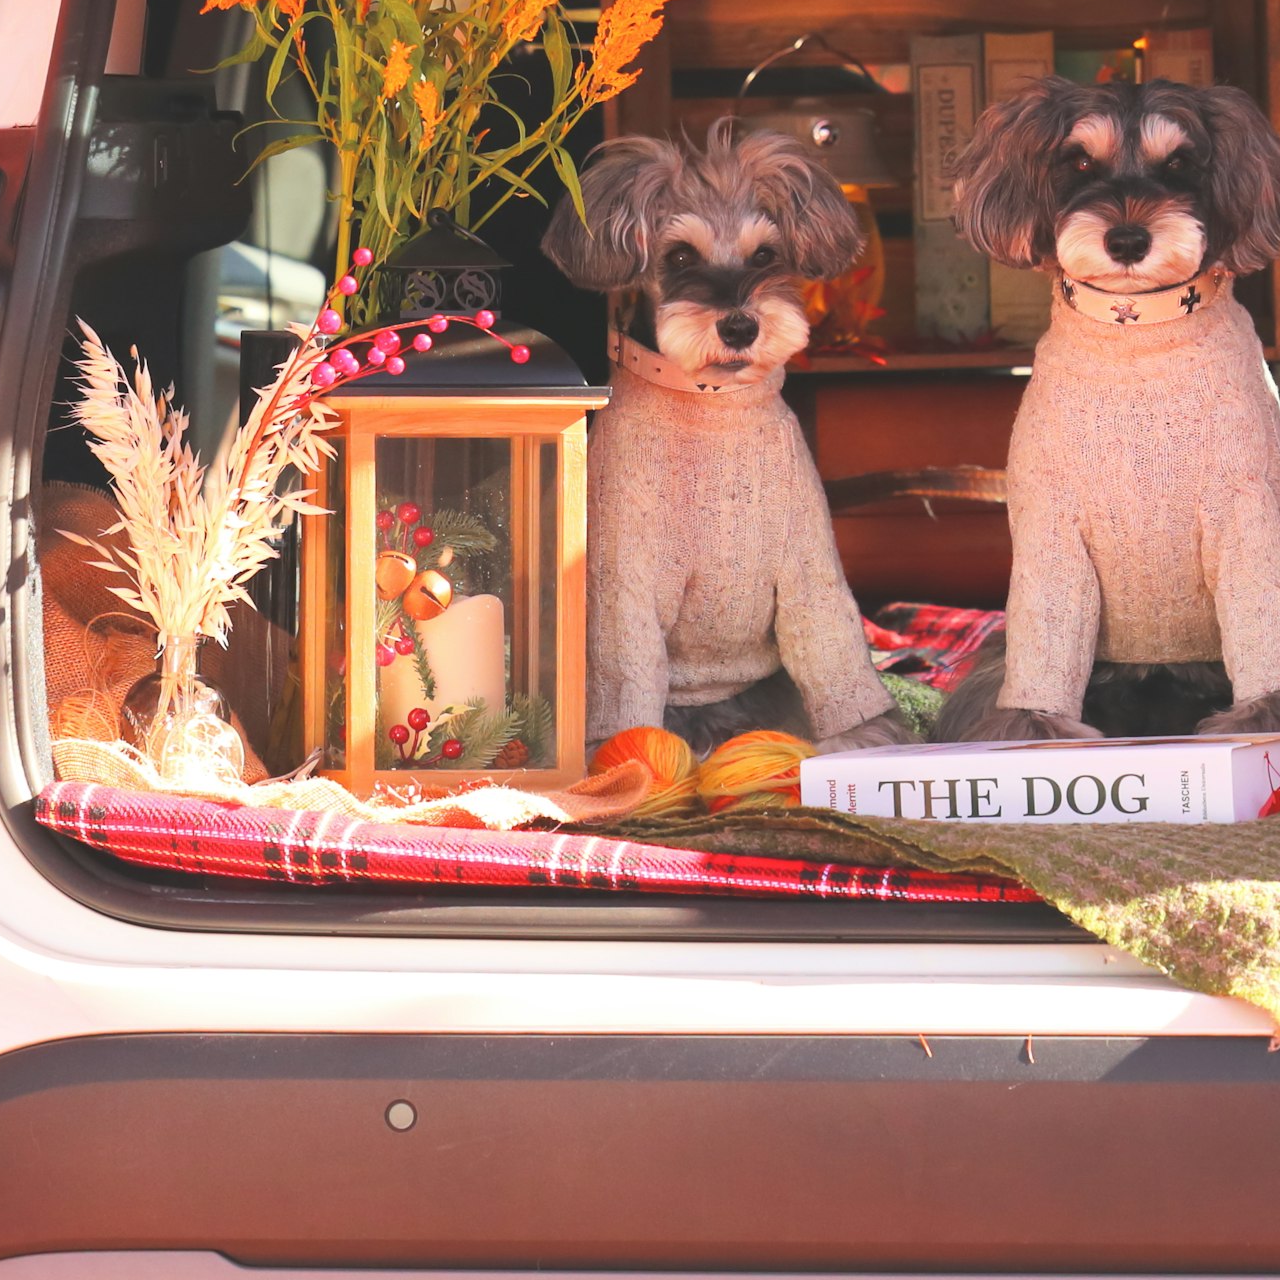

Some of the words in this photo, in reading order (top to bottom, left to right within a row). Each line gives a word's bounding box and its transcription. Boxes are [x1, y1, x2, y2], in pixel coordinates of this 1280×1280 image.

[827, 779, 837, 809] mond
[877, 776, 1003, 819] THE
[1021, 772, 1150, 818] DOG
[1180, 770, 1191, 815] TASCHEN
